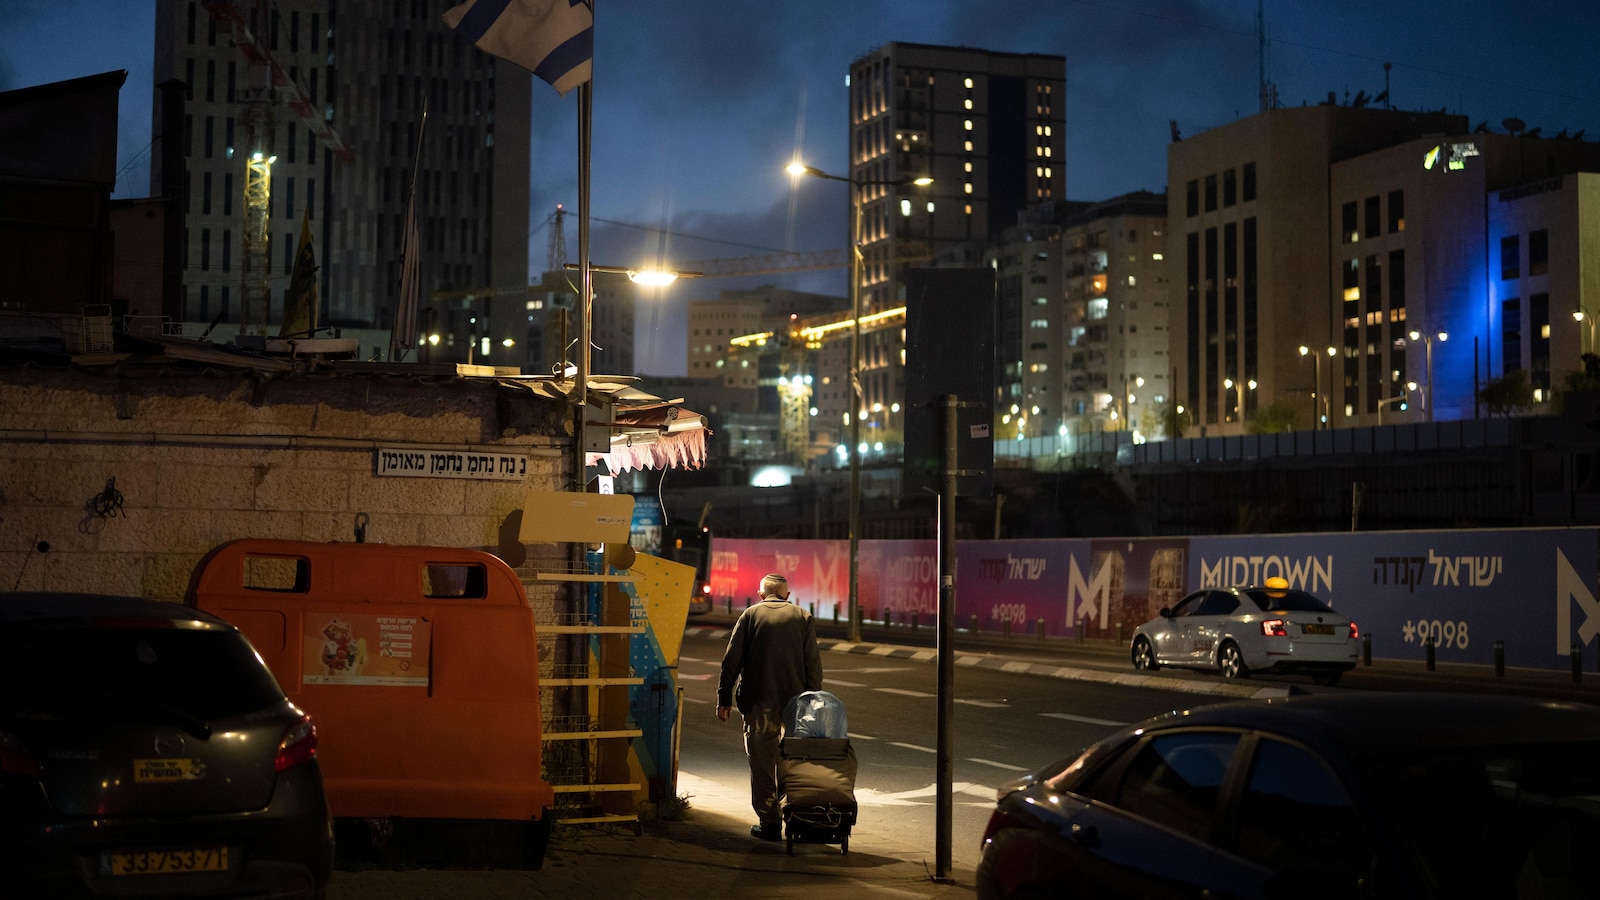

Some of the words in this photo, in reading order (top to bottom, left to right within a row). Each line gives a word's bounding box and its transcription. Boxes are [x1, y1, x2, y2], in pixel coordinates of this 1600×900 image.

[382, 452, 425, 473] מאומן
[1007, 553, 1047, 580] ישראל
[1199, 555, 1333, 593] MIDTOWN
[1373, 556, 1426, 593] קנדה
[1428, 548, 1503, 587] ישראל
